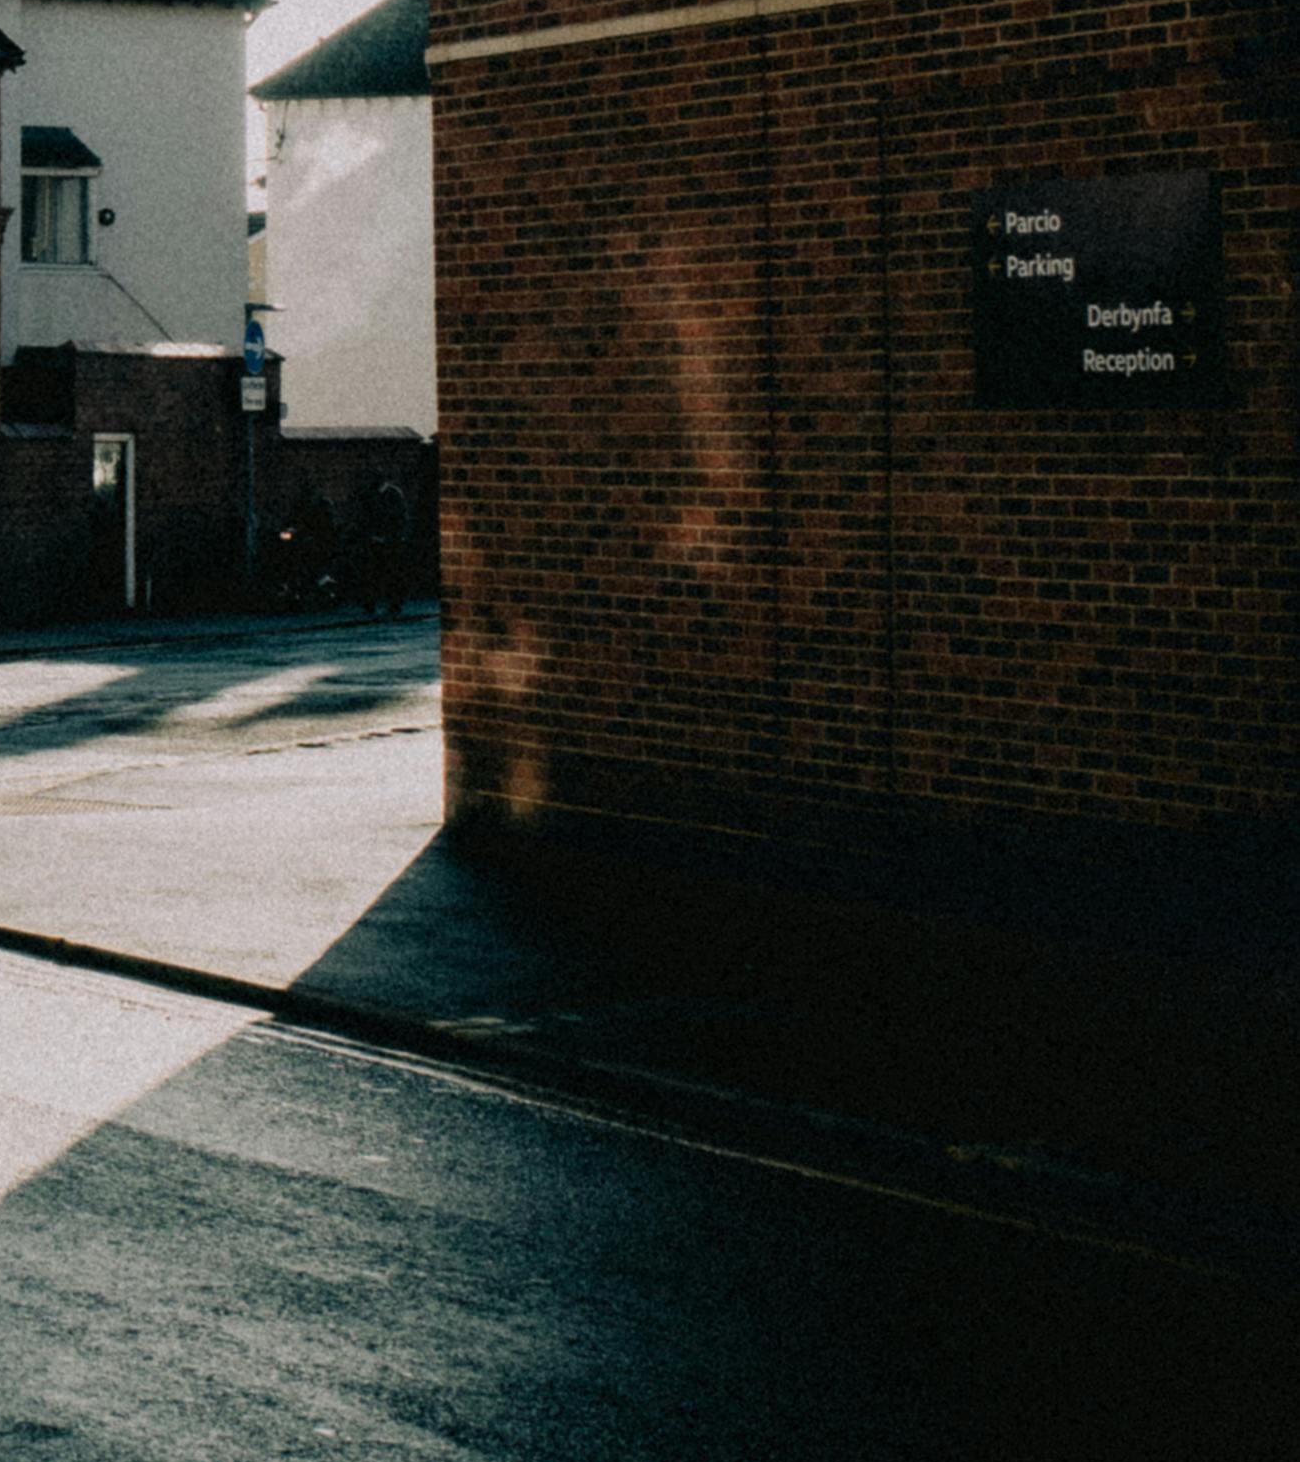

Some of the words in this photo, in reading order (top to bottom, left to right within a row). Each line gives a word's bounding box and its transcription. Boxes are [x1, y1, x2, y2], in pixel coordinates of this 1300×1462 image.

[1004, 207, 1063, 235] Parcio
[1005, 252, 1075, 283] Parking
[1086, 299, 1174, 334] Derbynfa
[1082, 346, 1176, 378] Reception
